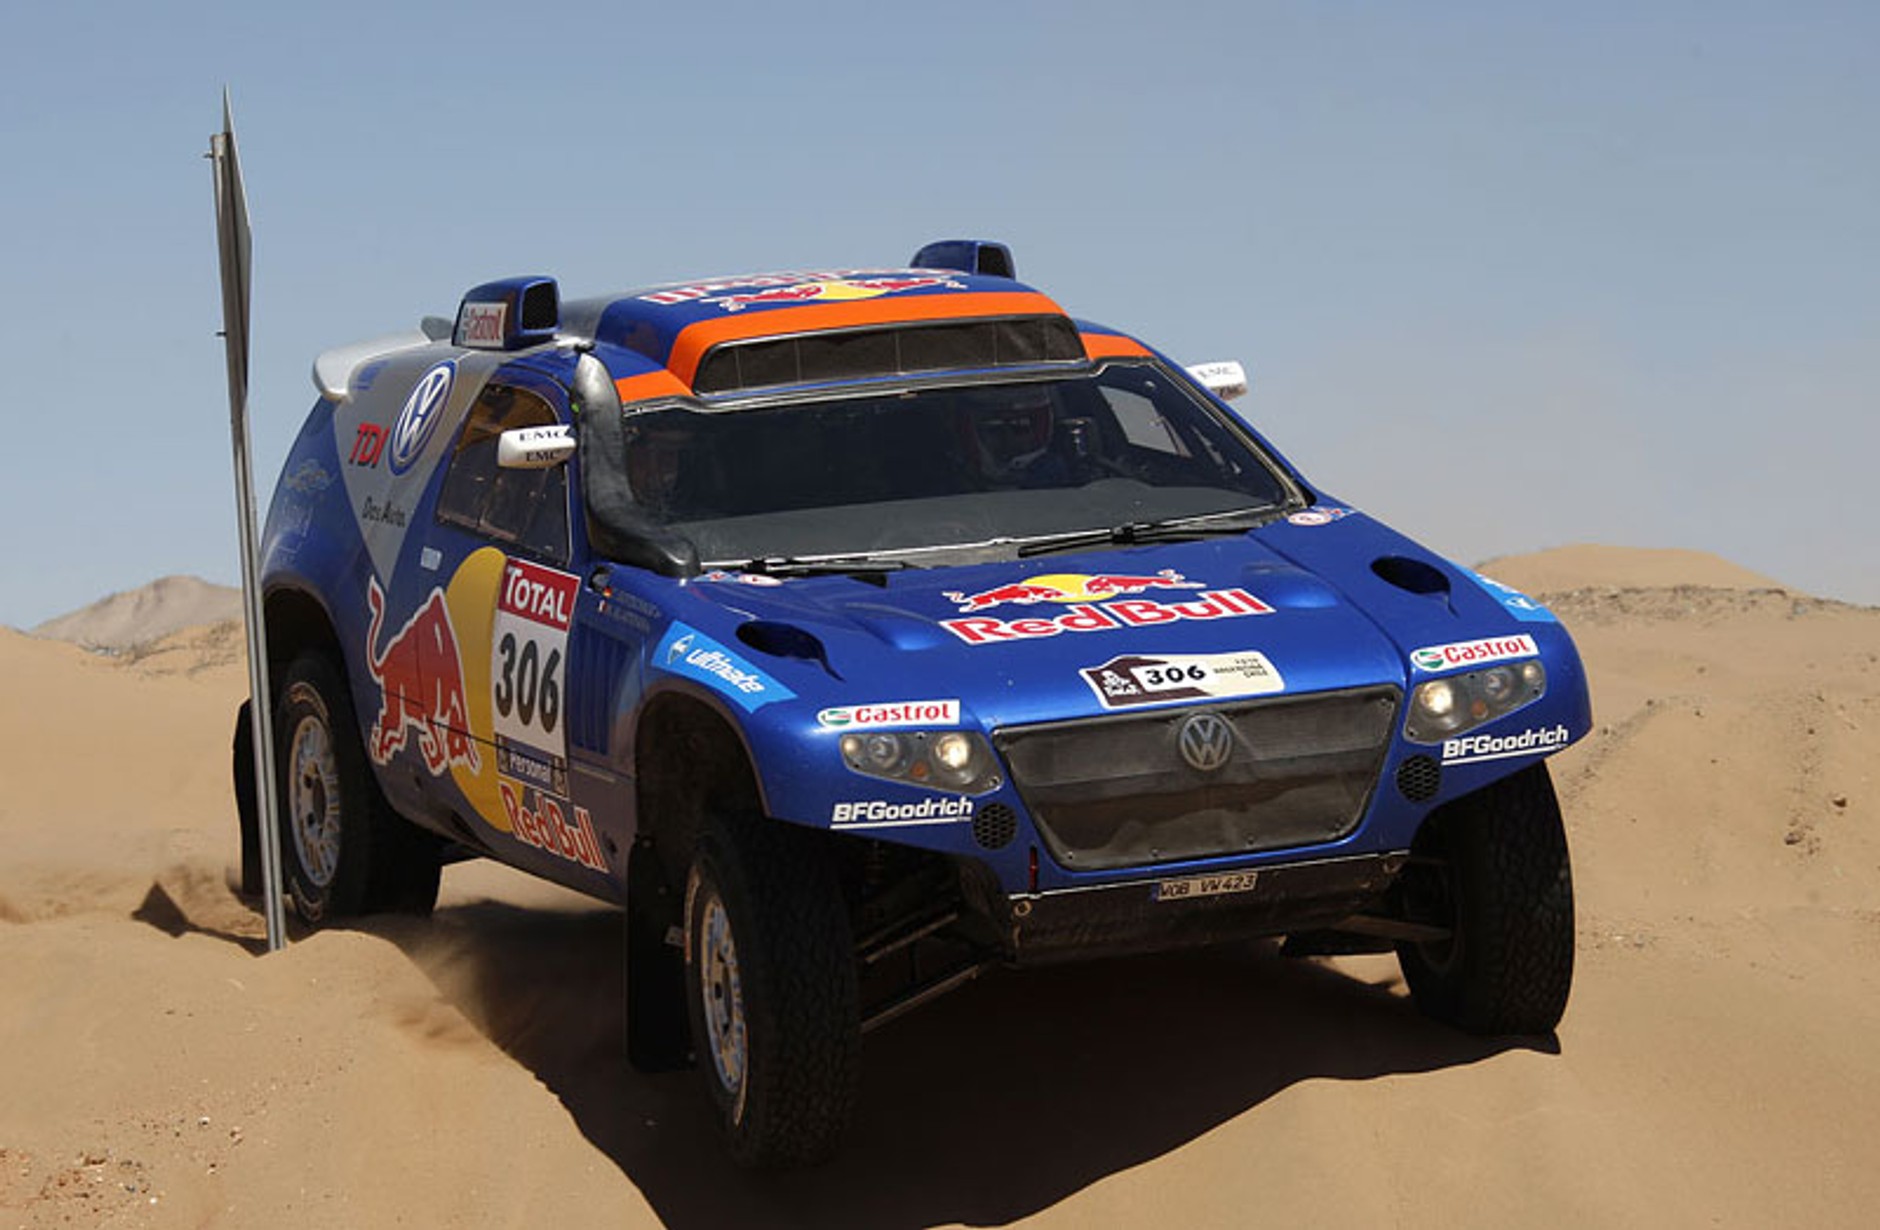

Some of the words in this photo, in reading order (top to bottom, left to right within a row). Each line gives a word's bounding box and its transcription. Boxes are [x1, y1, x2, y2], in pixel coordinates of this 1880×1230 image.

[348, 422, 391, 469] TDI
[939, 604, 1123, 645] Red
[1101, 589, 1276, 627] Bull
[1443, 637, 1531, 664] Castrol
[495, 632, 561, 734] 306
[686, 648, 766, 693] ultimate
[1144, 665, 1206, 685] 306
[855, 703, 951, 723] Castrol
[1442, 724, 1569, 758] BFGoodrich
[499, 781, 561, 856] Red
[544, 798, 610, 874] Bull
[832, 796, 973, 822] BFGoodrich
